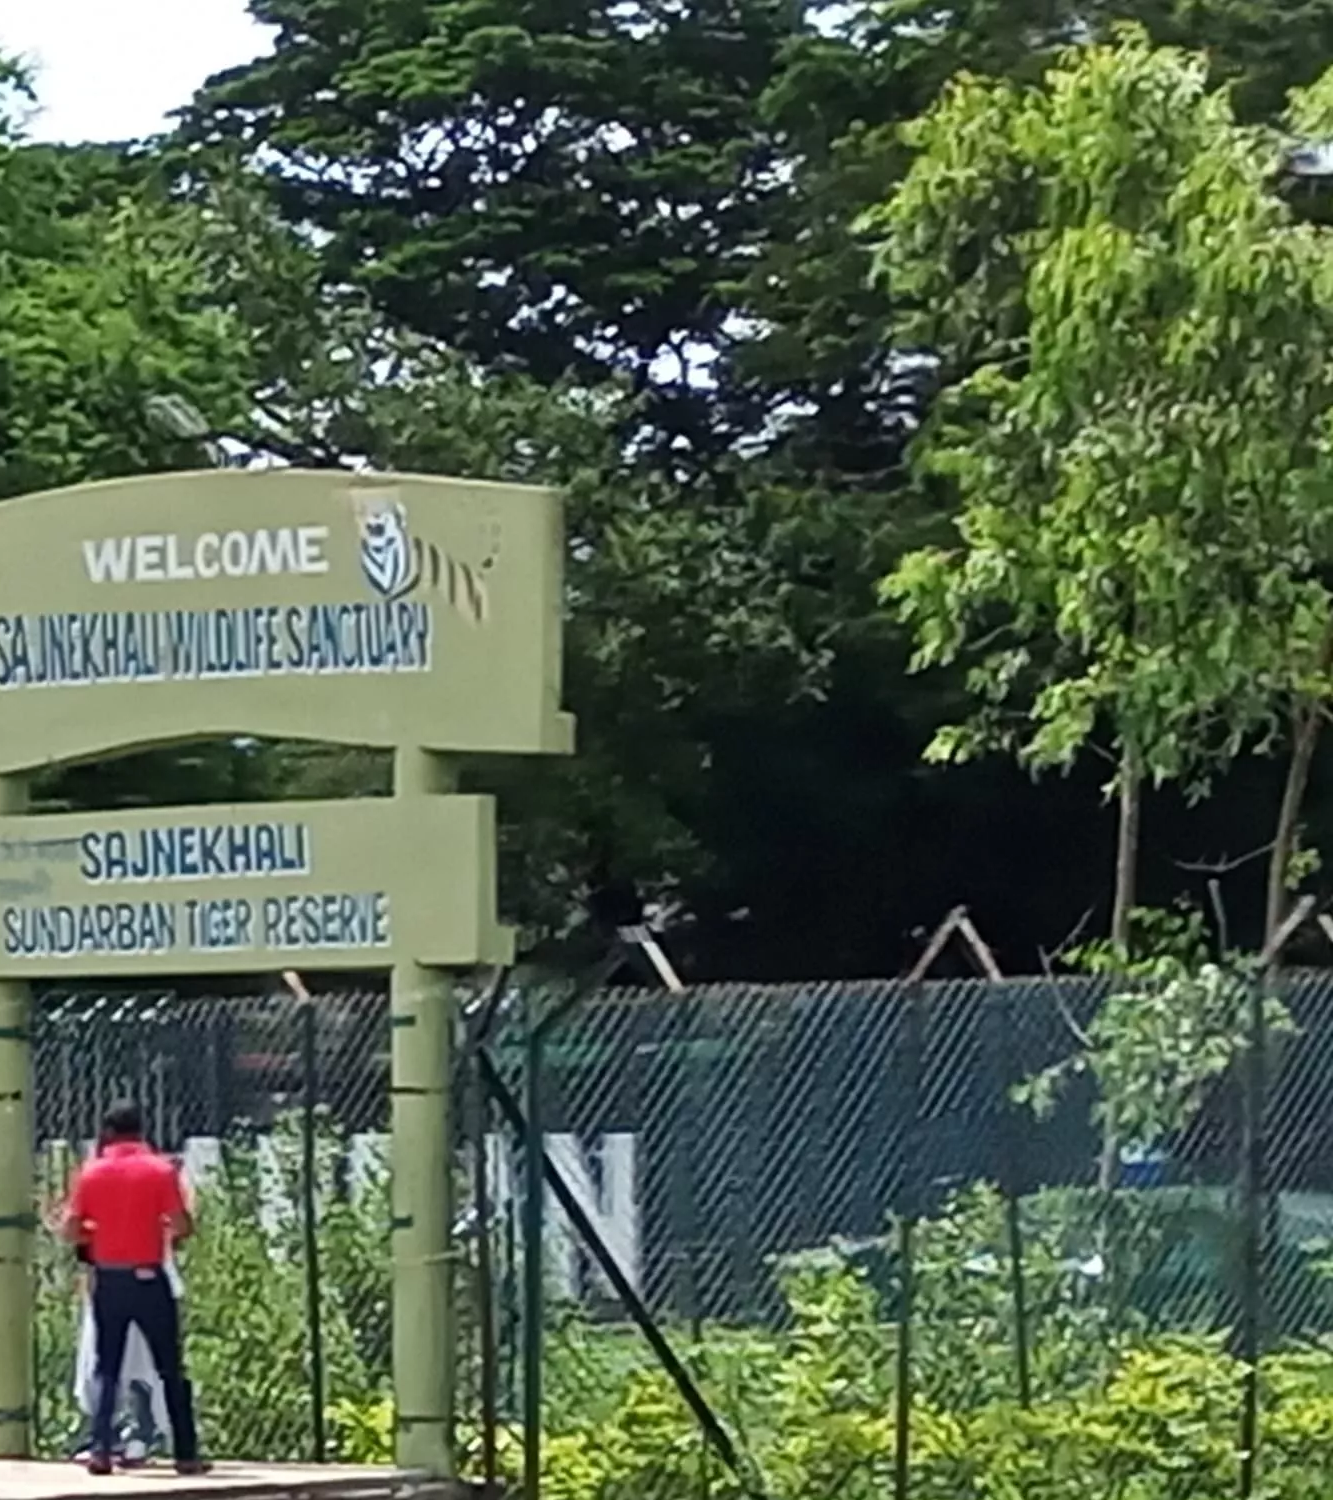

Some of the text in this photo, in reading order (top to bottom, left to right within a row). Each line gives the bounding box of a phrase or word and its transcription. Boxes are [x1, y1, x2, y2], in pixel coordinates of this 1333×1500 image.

[82, 526, 329, 583] WELCOME
[167, 605, 285, 680] WILDLIFE
[286, 601, 431, 676] SANCTUARY
[80, 823, 309, 884] SAJNEKHALI
[3, 892, 391, 957] SUNDARBAN TIGER RESERVE
